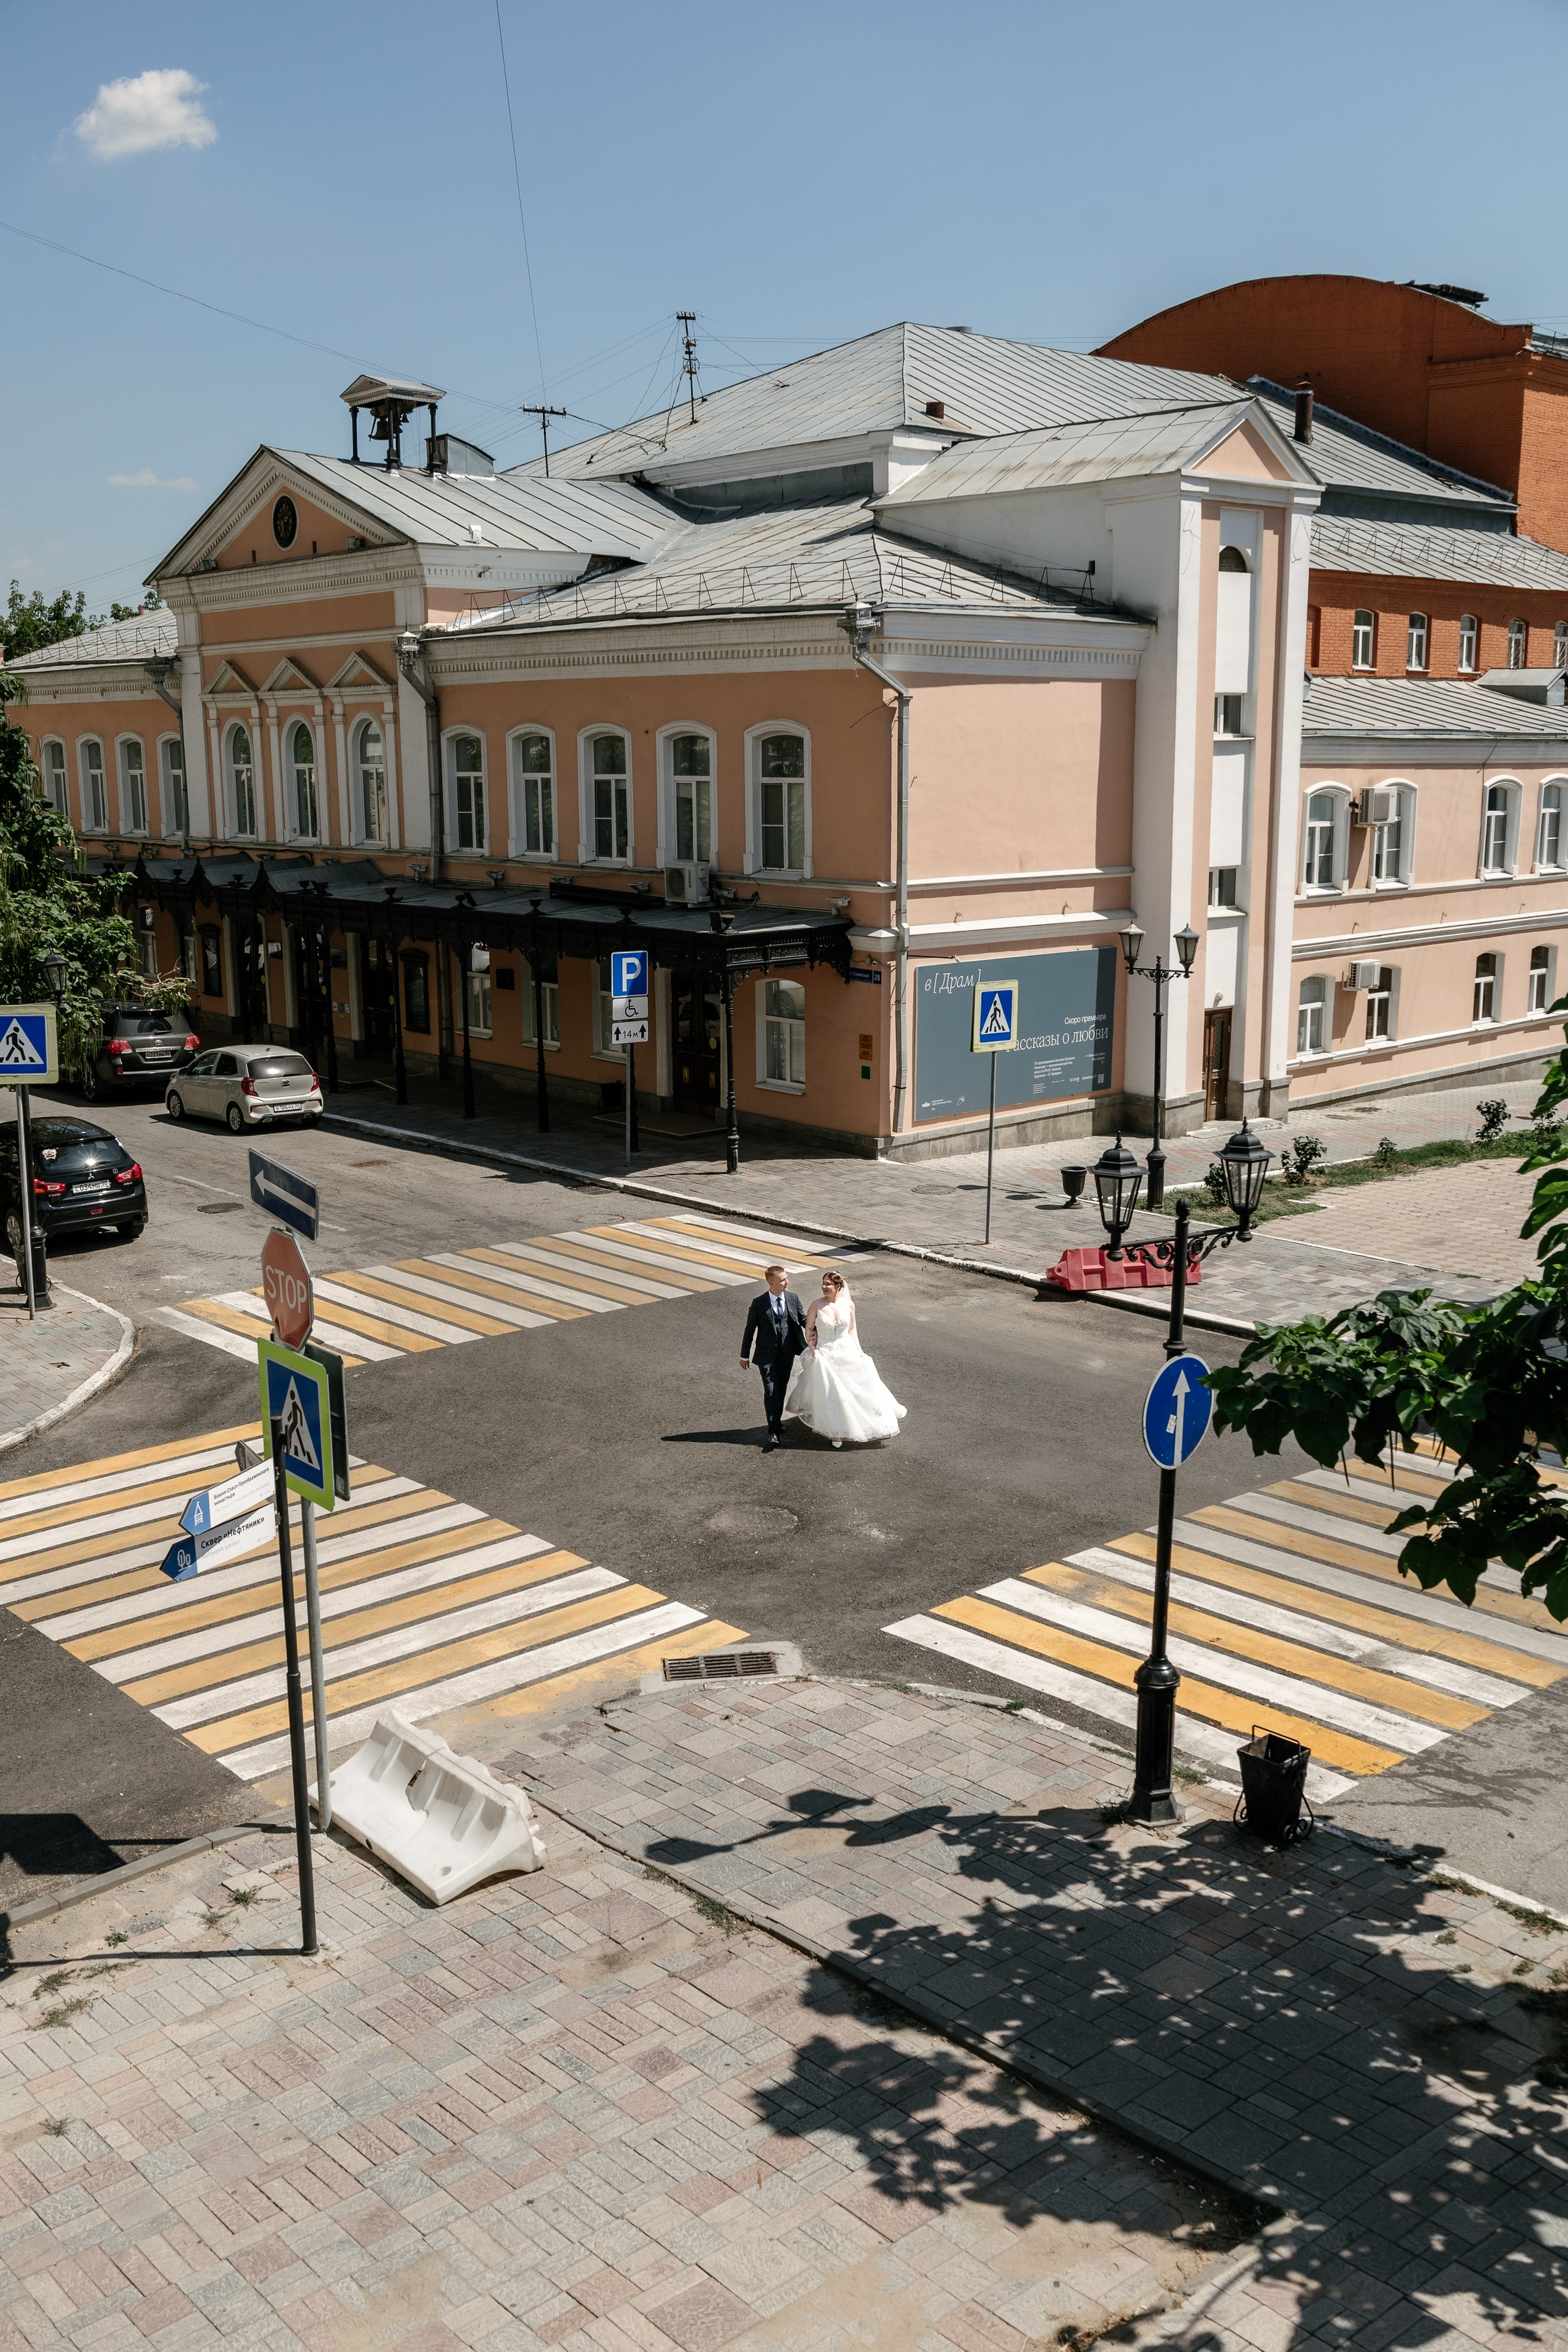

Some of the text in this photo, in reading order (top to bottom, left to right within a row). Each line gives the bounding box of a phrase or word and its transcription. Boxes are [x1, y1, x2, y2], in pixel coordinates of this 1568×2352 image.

[622, 957, 641, 992] P
[1081, 1014, 1107, 1023] премьера
[1006, 1023, 1109, 1052] ассказы о любви
[75, 1183, 100, 1192] С034МВ
[265, 1264, 307, 1314] STOP
[213, 1467, 270, 1500] Башня Спасо-Преображенского
[214, 1492, 236, 1506] монастыря
[200, 1517, 265, 1548] Сквер «Нефтяник»
[202, 1539, 240, 1559] Neftyanik garden
